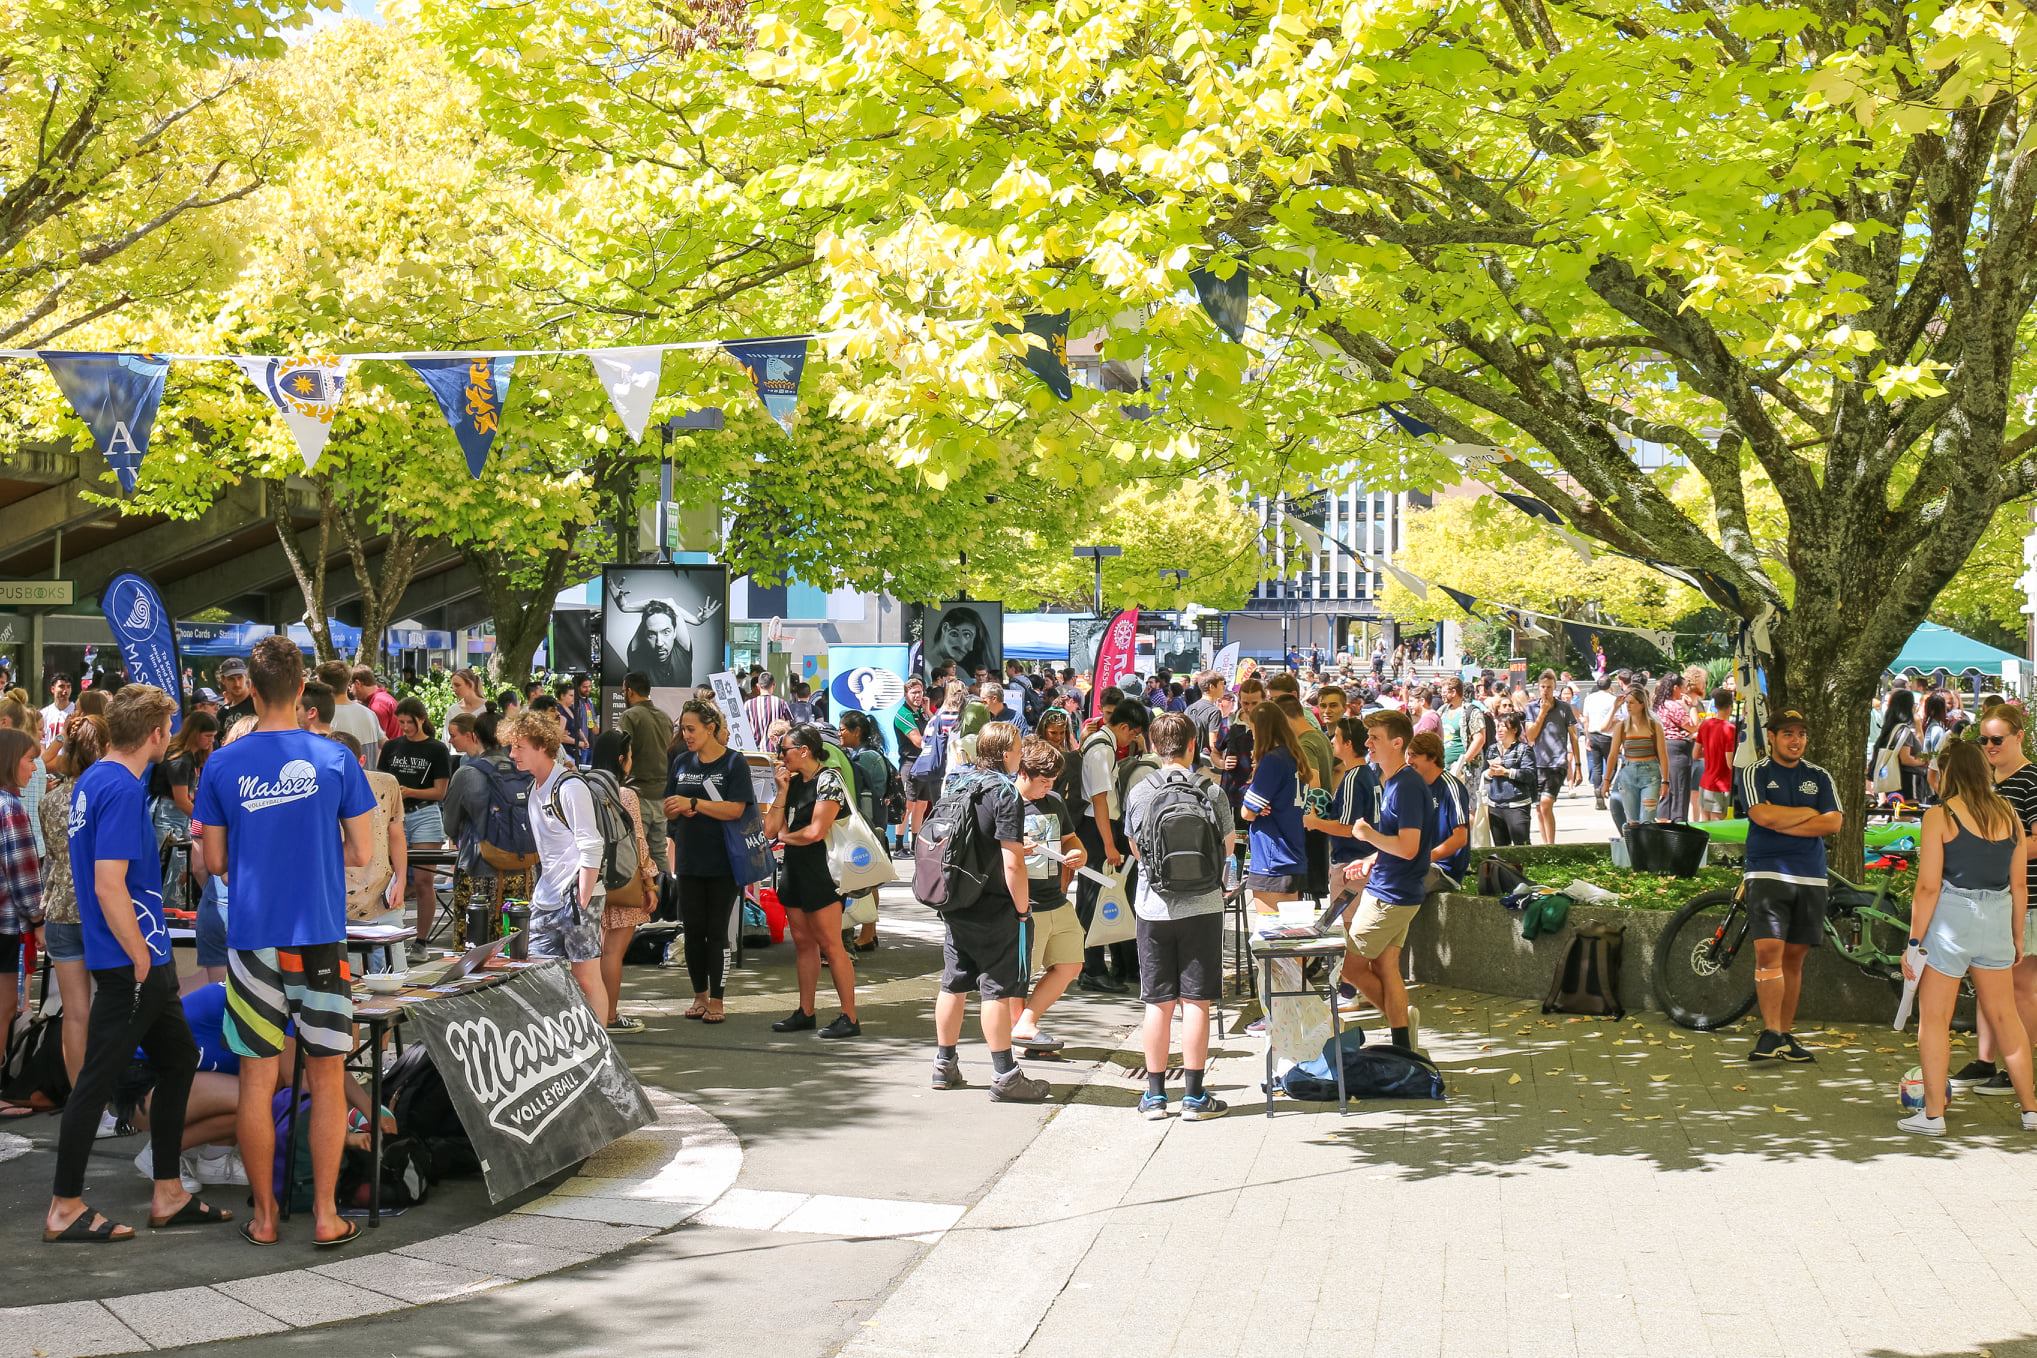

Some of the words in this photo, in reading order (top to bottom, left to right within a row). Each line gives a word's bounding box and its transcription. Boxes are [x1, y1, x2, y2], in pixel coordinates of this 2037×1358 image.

[392, 755, 408, 766] Jack
[410, 756, 428, 767] Wills
[238, 775, 319, 799] Massey
[247, 799, 283, 809] VOLLEYBALL
[446, 1005, 611, 1103] Massey
[510, 1072, 579, 1125] VOLLEYBALL
